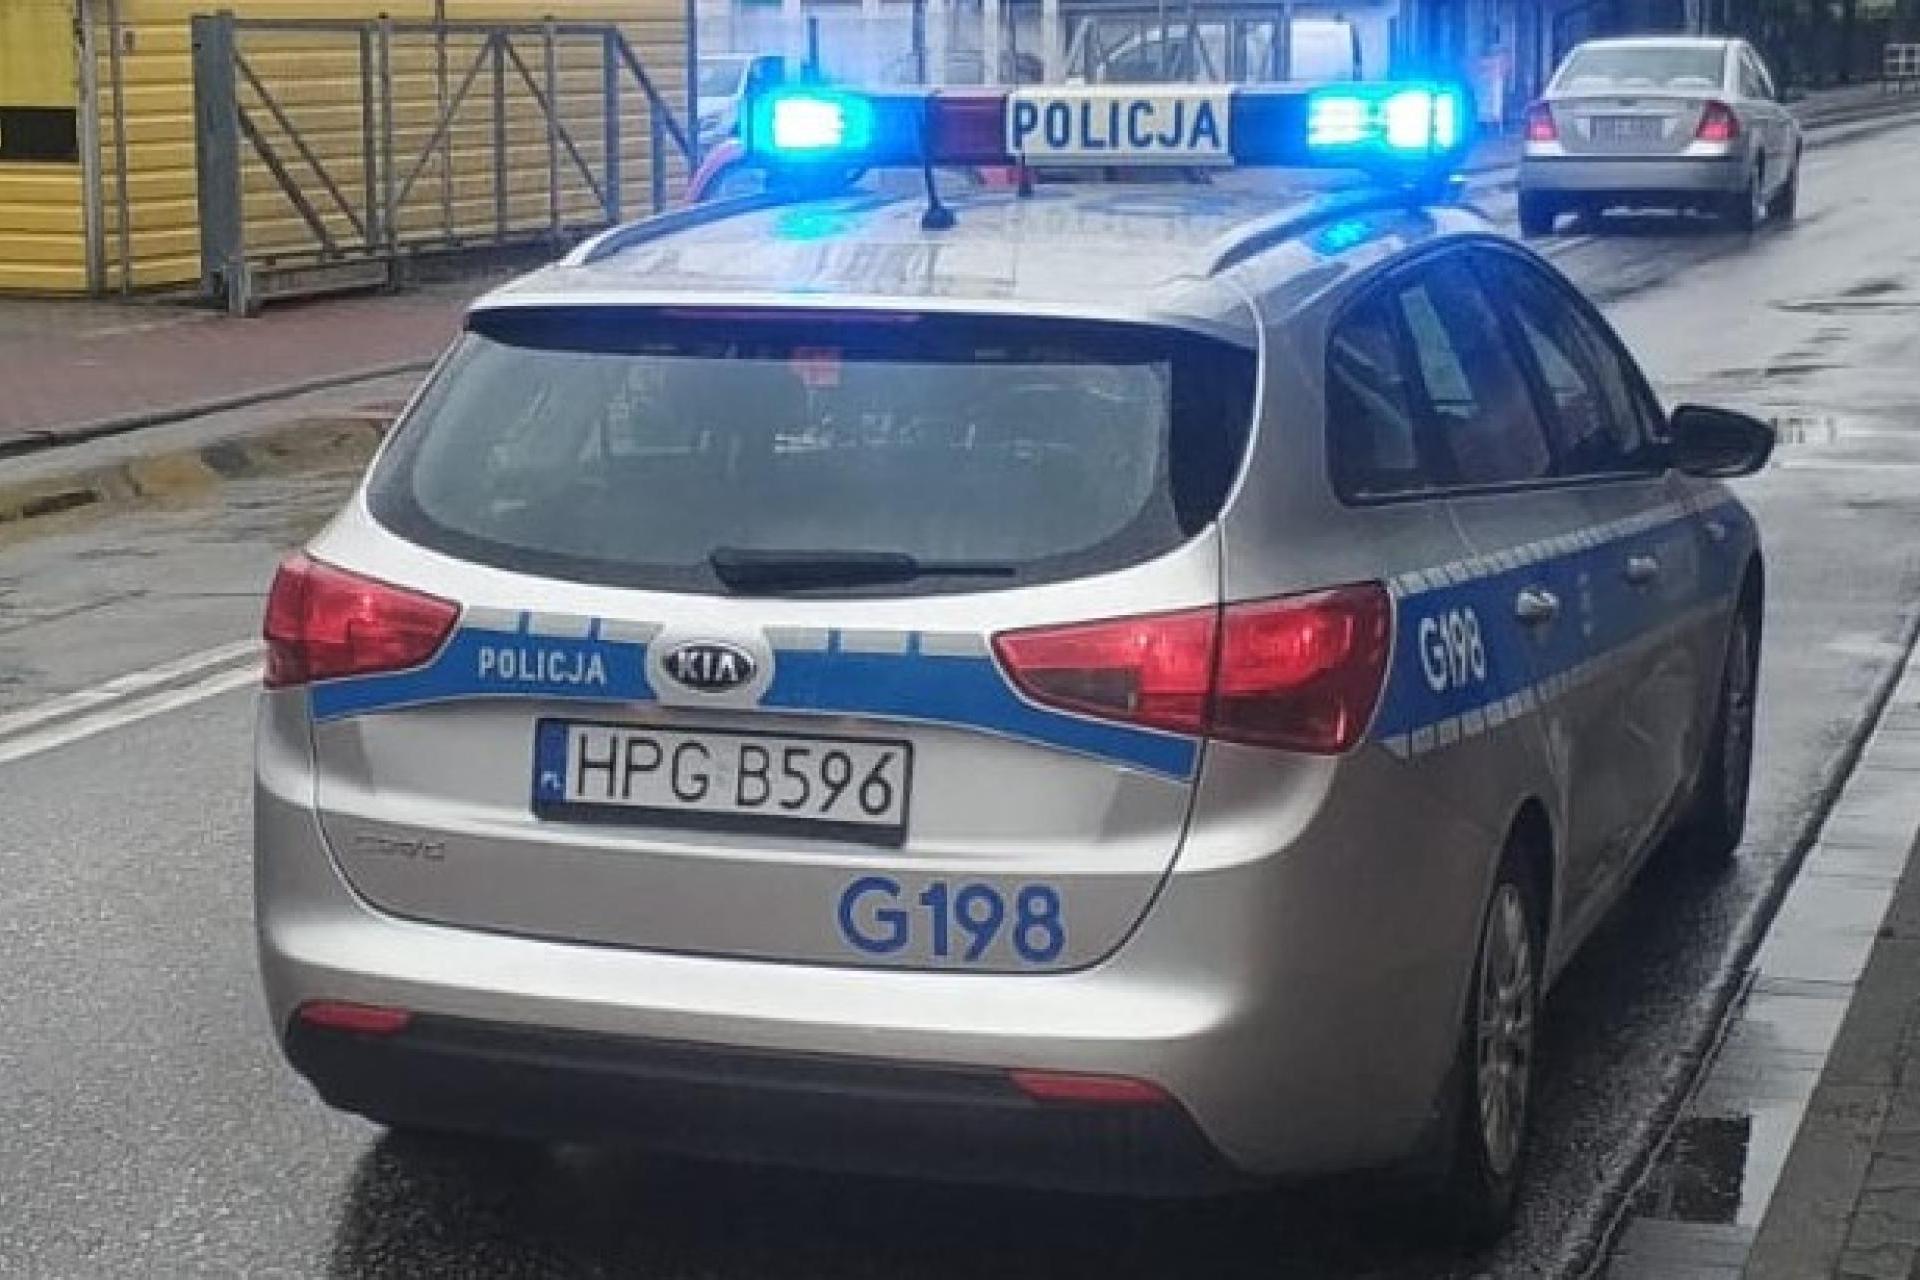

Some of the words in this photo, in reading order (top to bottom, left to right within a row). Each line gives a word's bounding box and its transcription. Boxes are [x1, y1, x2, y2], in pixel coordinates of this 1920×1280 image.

[1012, 99, 1220, 149] POLICJA
[477, 648, 608, 686] POLICJA
[676, 649, 740, 682] KIA
[576, 733, 710, 802] HPG
[736, 743, 896, 815] B596
[838, 876, 1066, 963] G198
